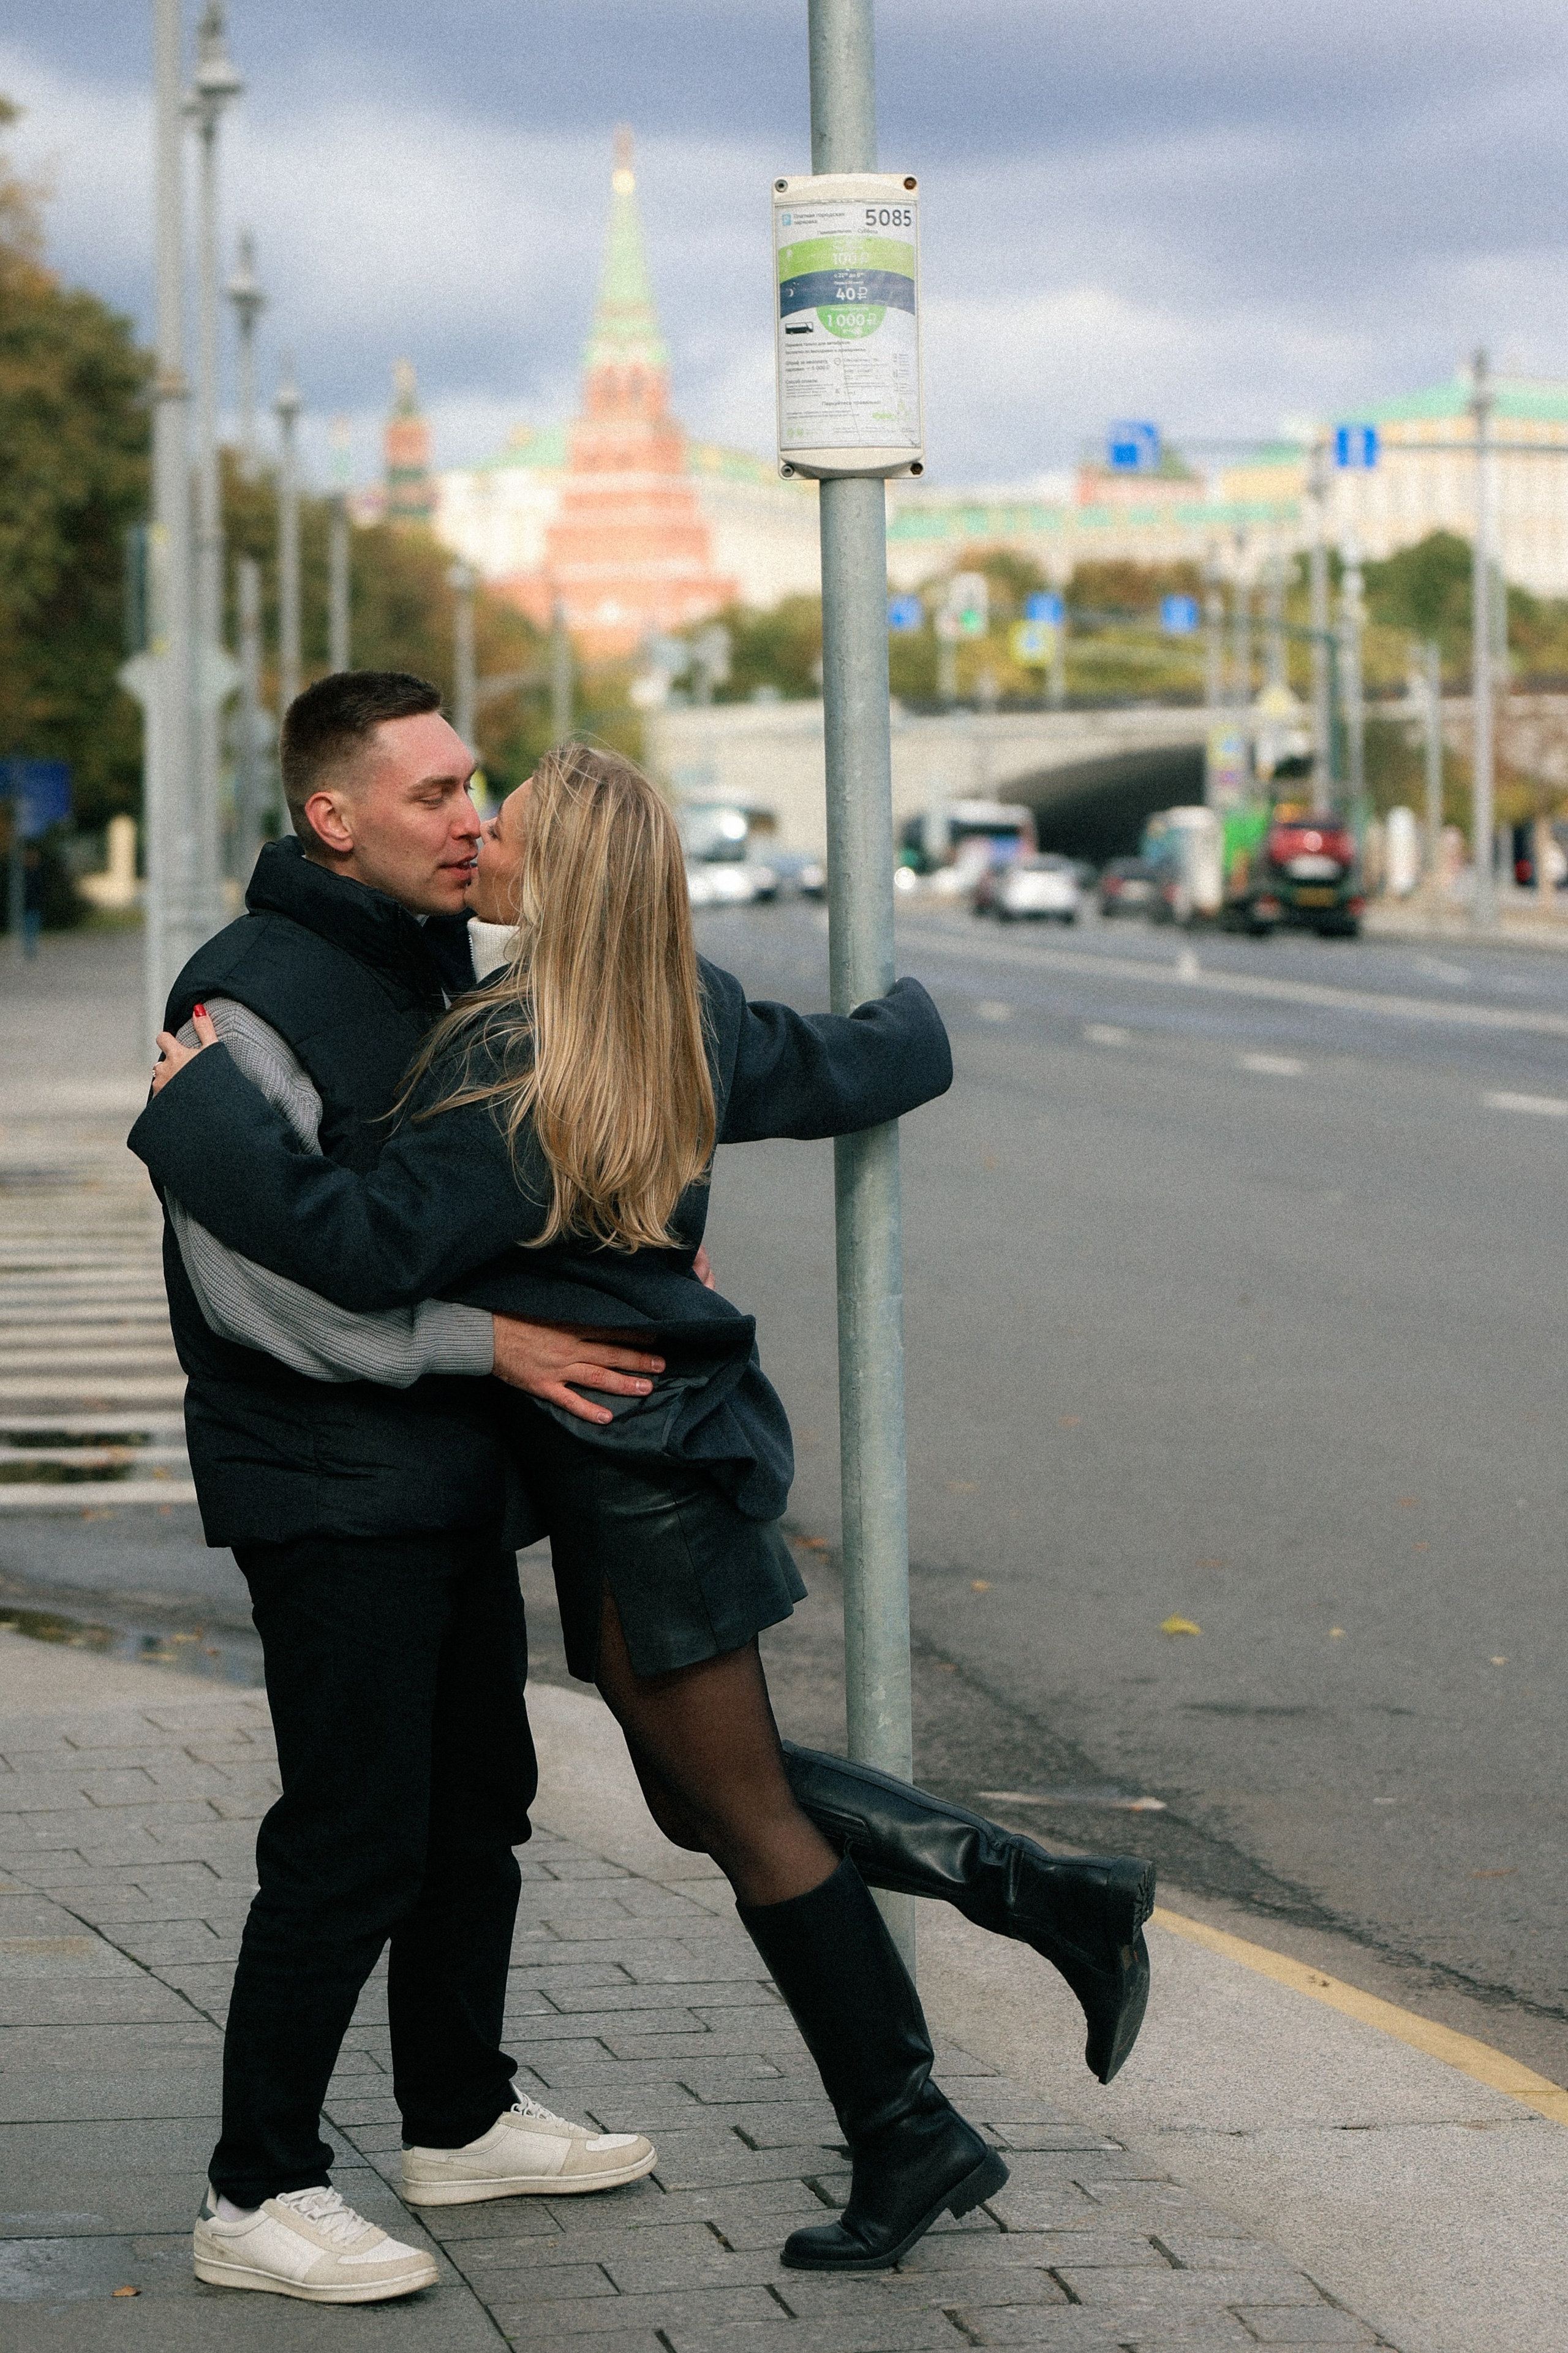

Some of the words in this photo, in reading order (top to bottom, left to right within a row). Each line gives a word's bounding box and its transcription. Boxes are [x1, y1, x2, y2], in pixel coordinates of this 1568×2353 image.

[865, 209, 911, 227] 5085
[833, 252, 857, 265] 100
[836, 287, 856, 300] 40
